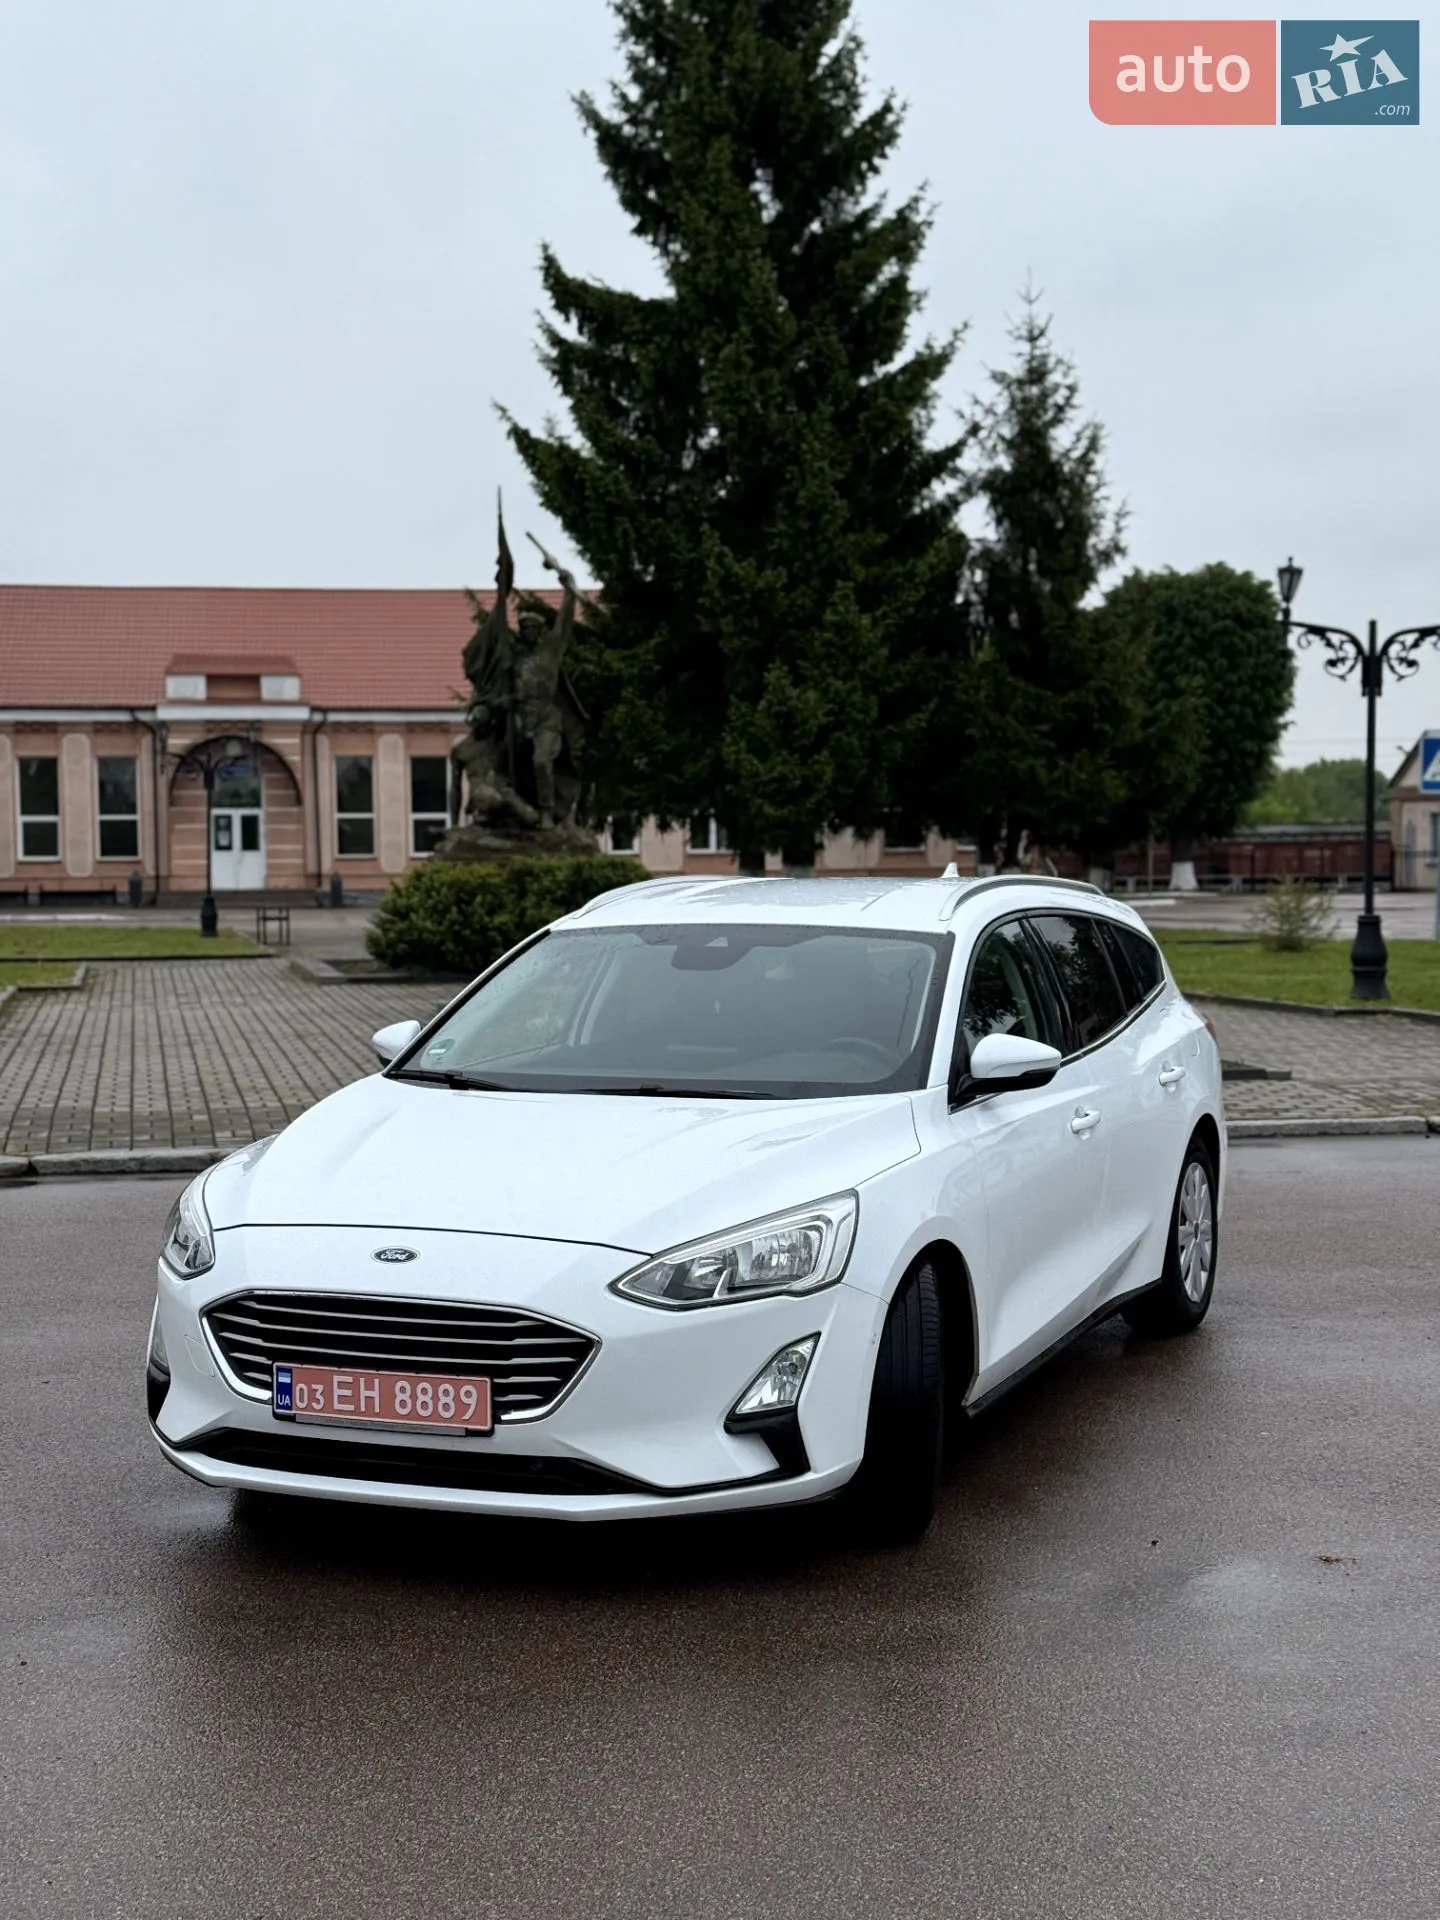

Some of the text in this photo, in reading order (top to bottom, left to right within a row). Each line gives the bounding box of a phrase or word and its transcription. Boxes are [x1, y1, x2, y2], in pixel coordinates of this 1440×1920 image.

[380, 1249, 410, 1260] Ford
[277, 1394, 291, 1407] UA
[295, 1375, 478, 1420] 03 EH 8889
